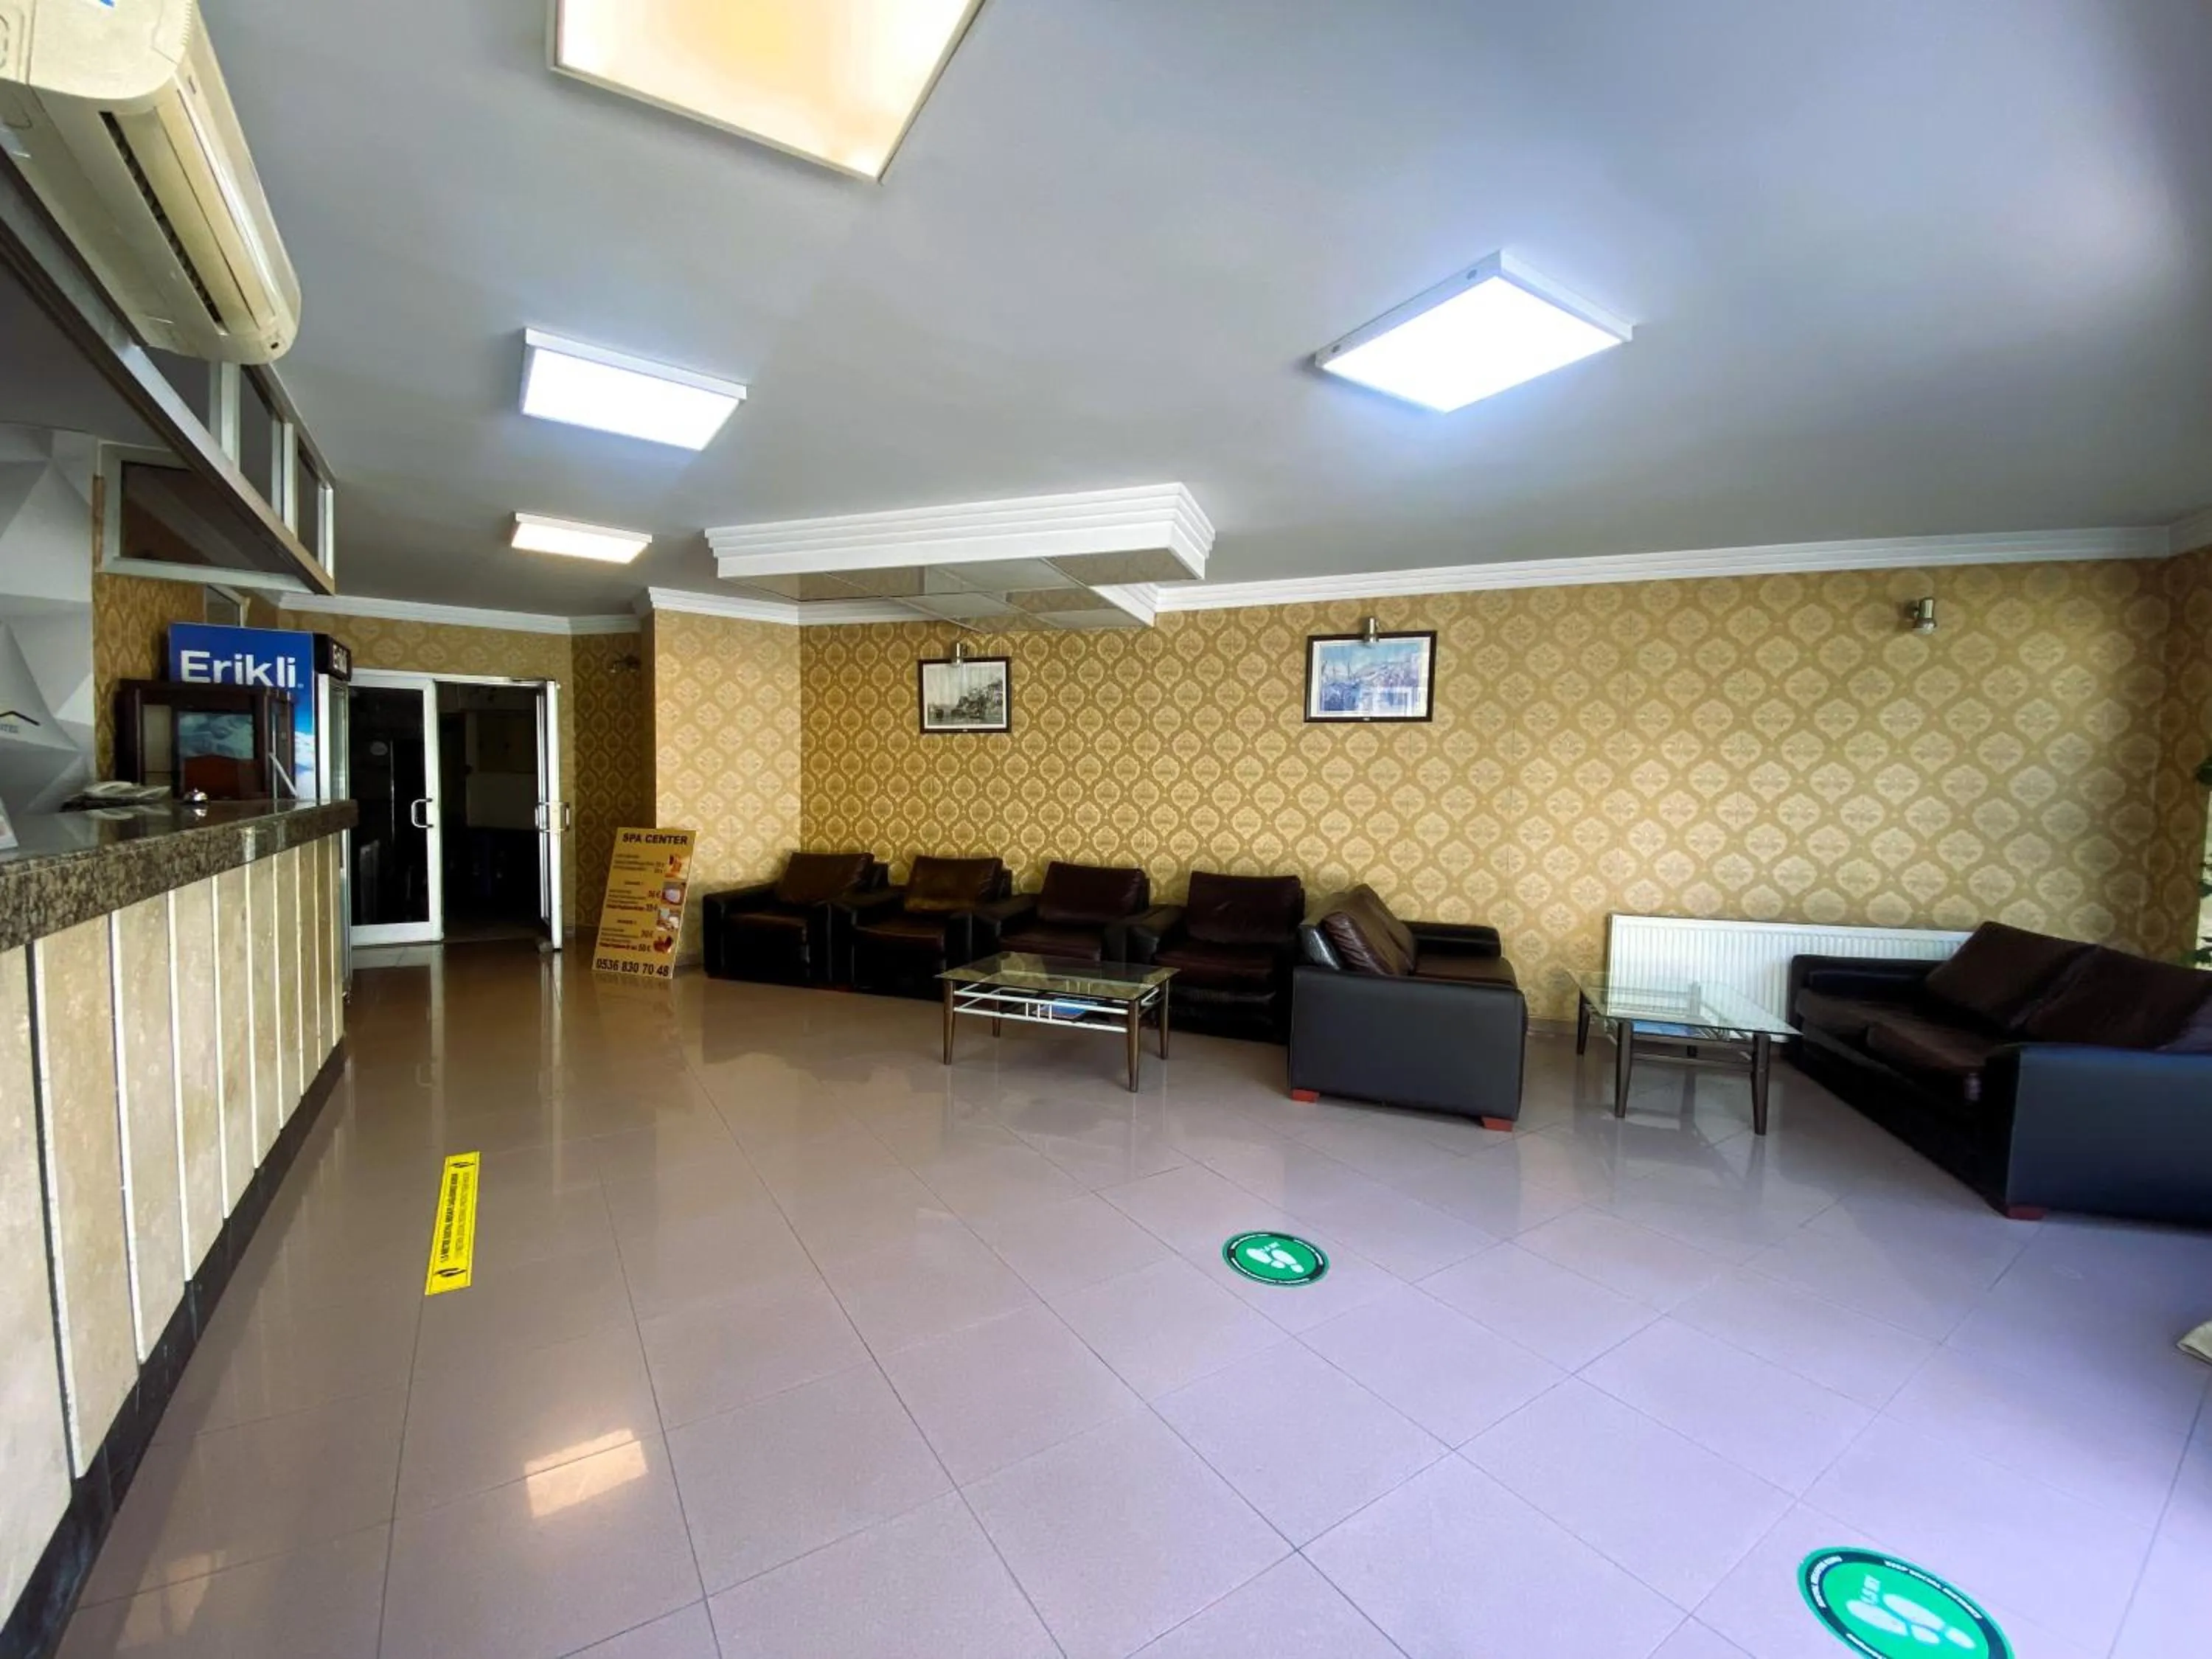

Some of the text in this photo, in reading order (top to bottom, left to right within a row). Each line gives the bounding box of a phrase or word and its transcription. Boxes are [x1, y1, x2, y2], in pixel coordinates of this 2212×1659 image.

[181, 650, 296, 688] Erikli
[623, 832, 688, 846] SPA CENTER
[596, 958, 669, 977] 0536 830 70 48
